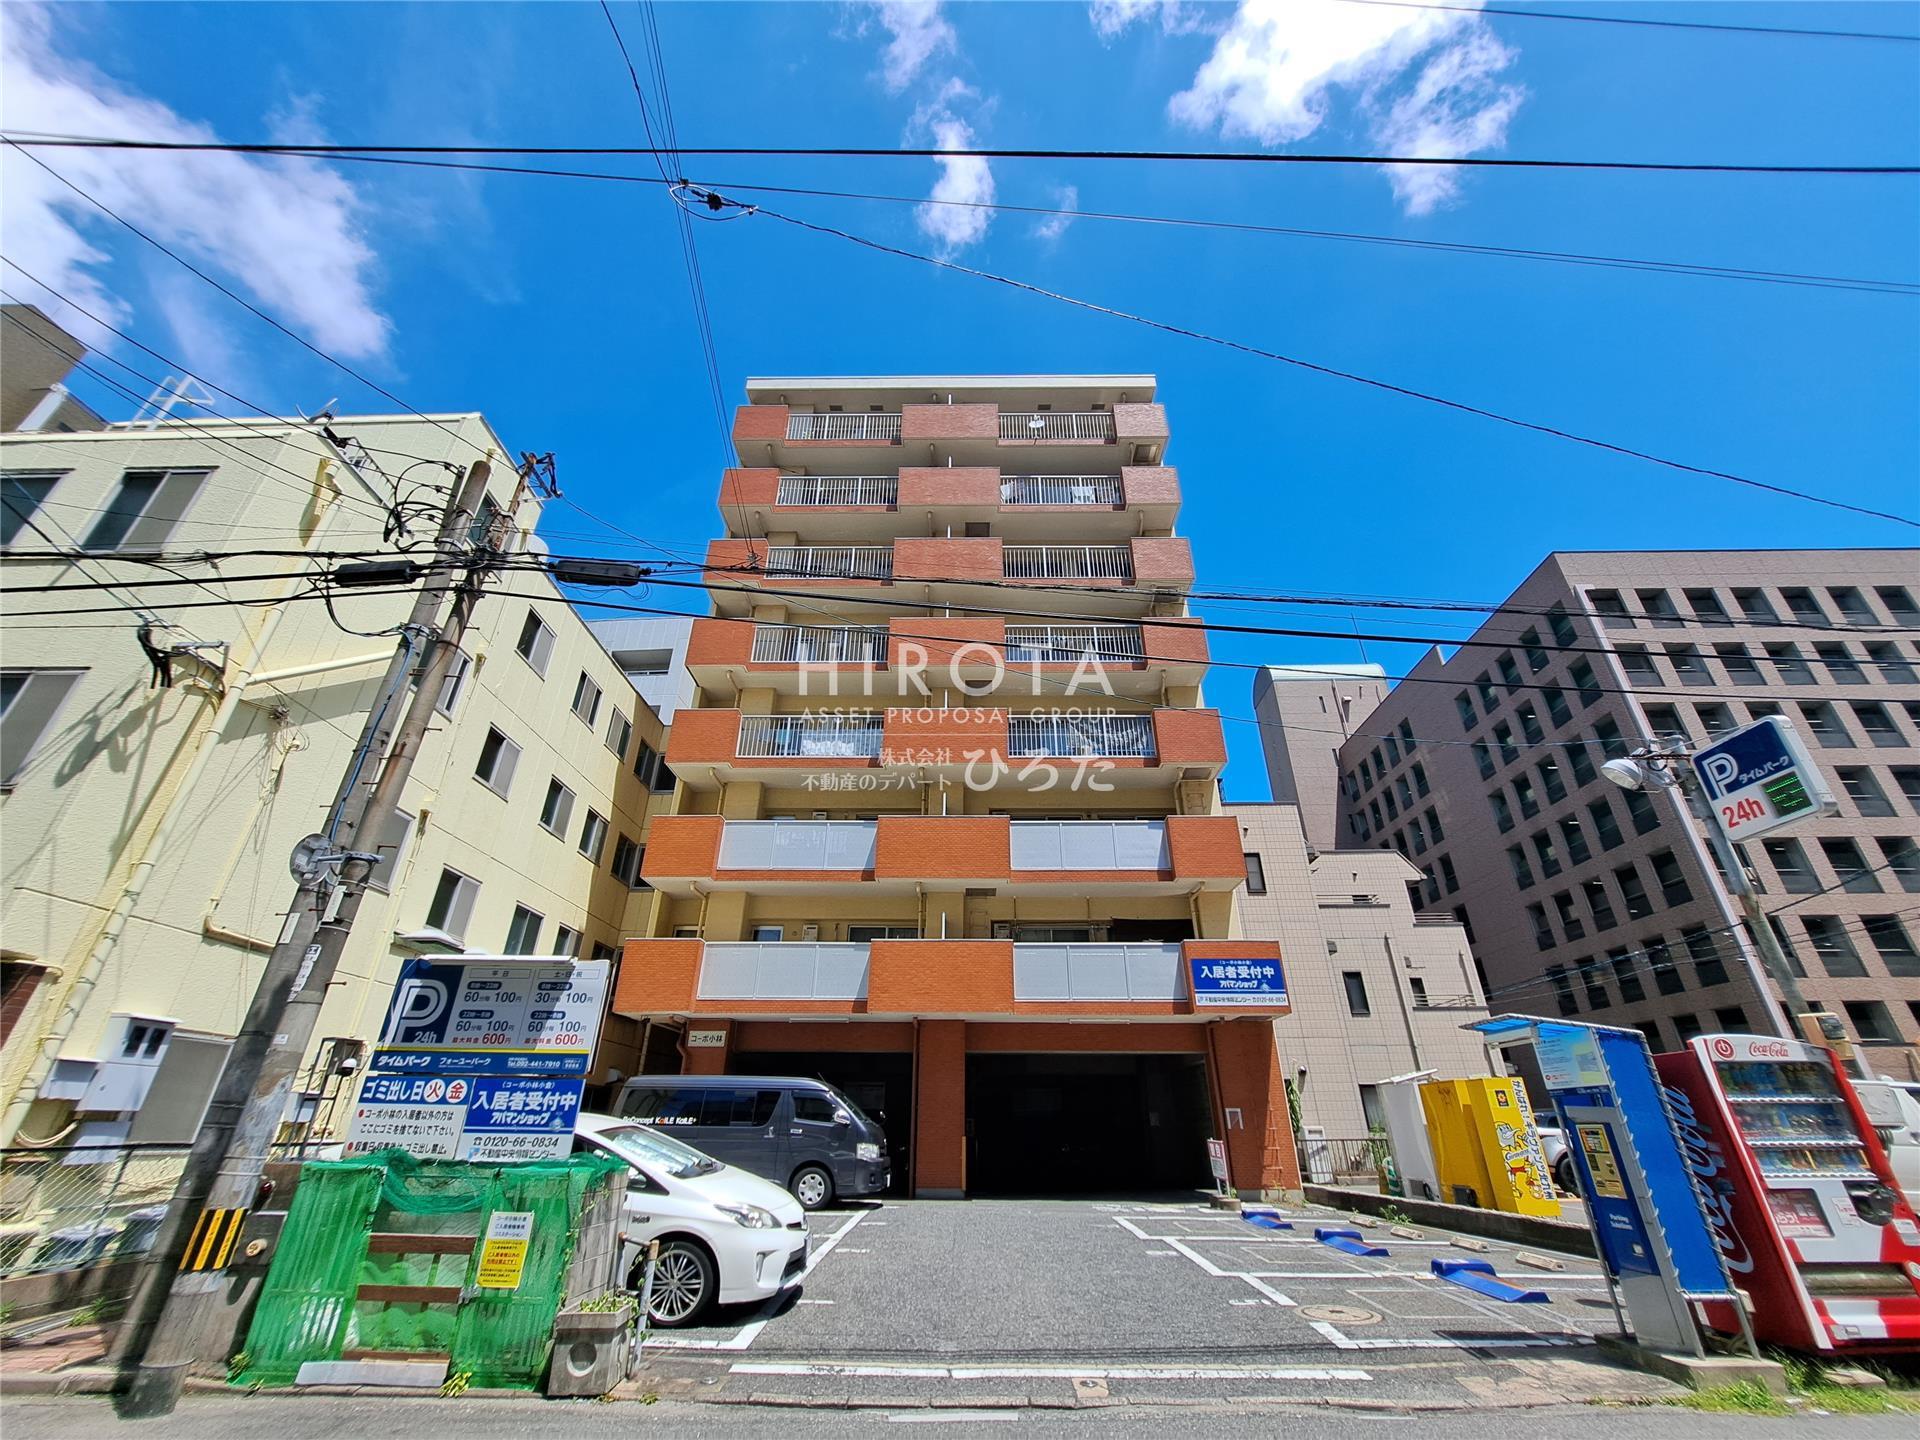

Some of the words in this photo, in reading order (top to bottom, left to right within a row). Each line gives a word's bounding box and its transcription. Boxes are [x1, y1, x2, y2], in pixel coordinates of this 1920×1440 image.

[1738, 755, 1789, 784] タイムパーク
[1722, 797, 1766, 829] 24h
[1200, 965, 1275, 979] 入居者受付中
[414, 1031, 438, 1043] 24h
[690, 1035, 723, 1043] コーポ小林
[1749, 1041, 1790, 1057] Coca-Cola
[377, 1055, 432, 1067] タイムパーク
[362, 1080, 425, 1101] ゴミ出し日
[426, 1082, 442, 1098] 火
[448, 1082, 465, 1100] 金
[472, 1091, 577, 1111] 入居者受付中
[489, 1112, 550, 1125] アパマンショップ
[483, 1136, 559, 1147] 0120-66-0834
